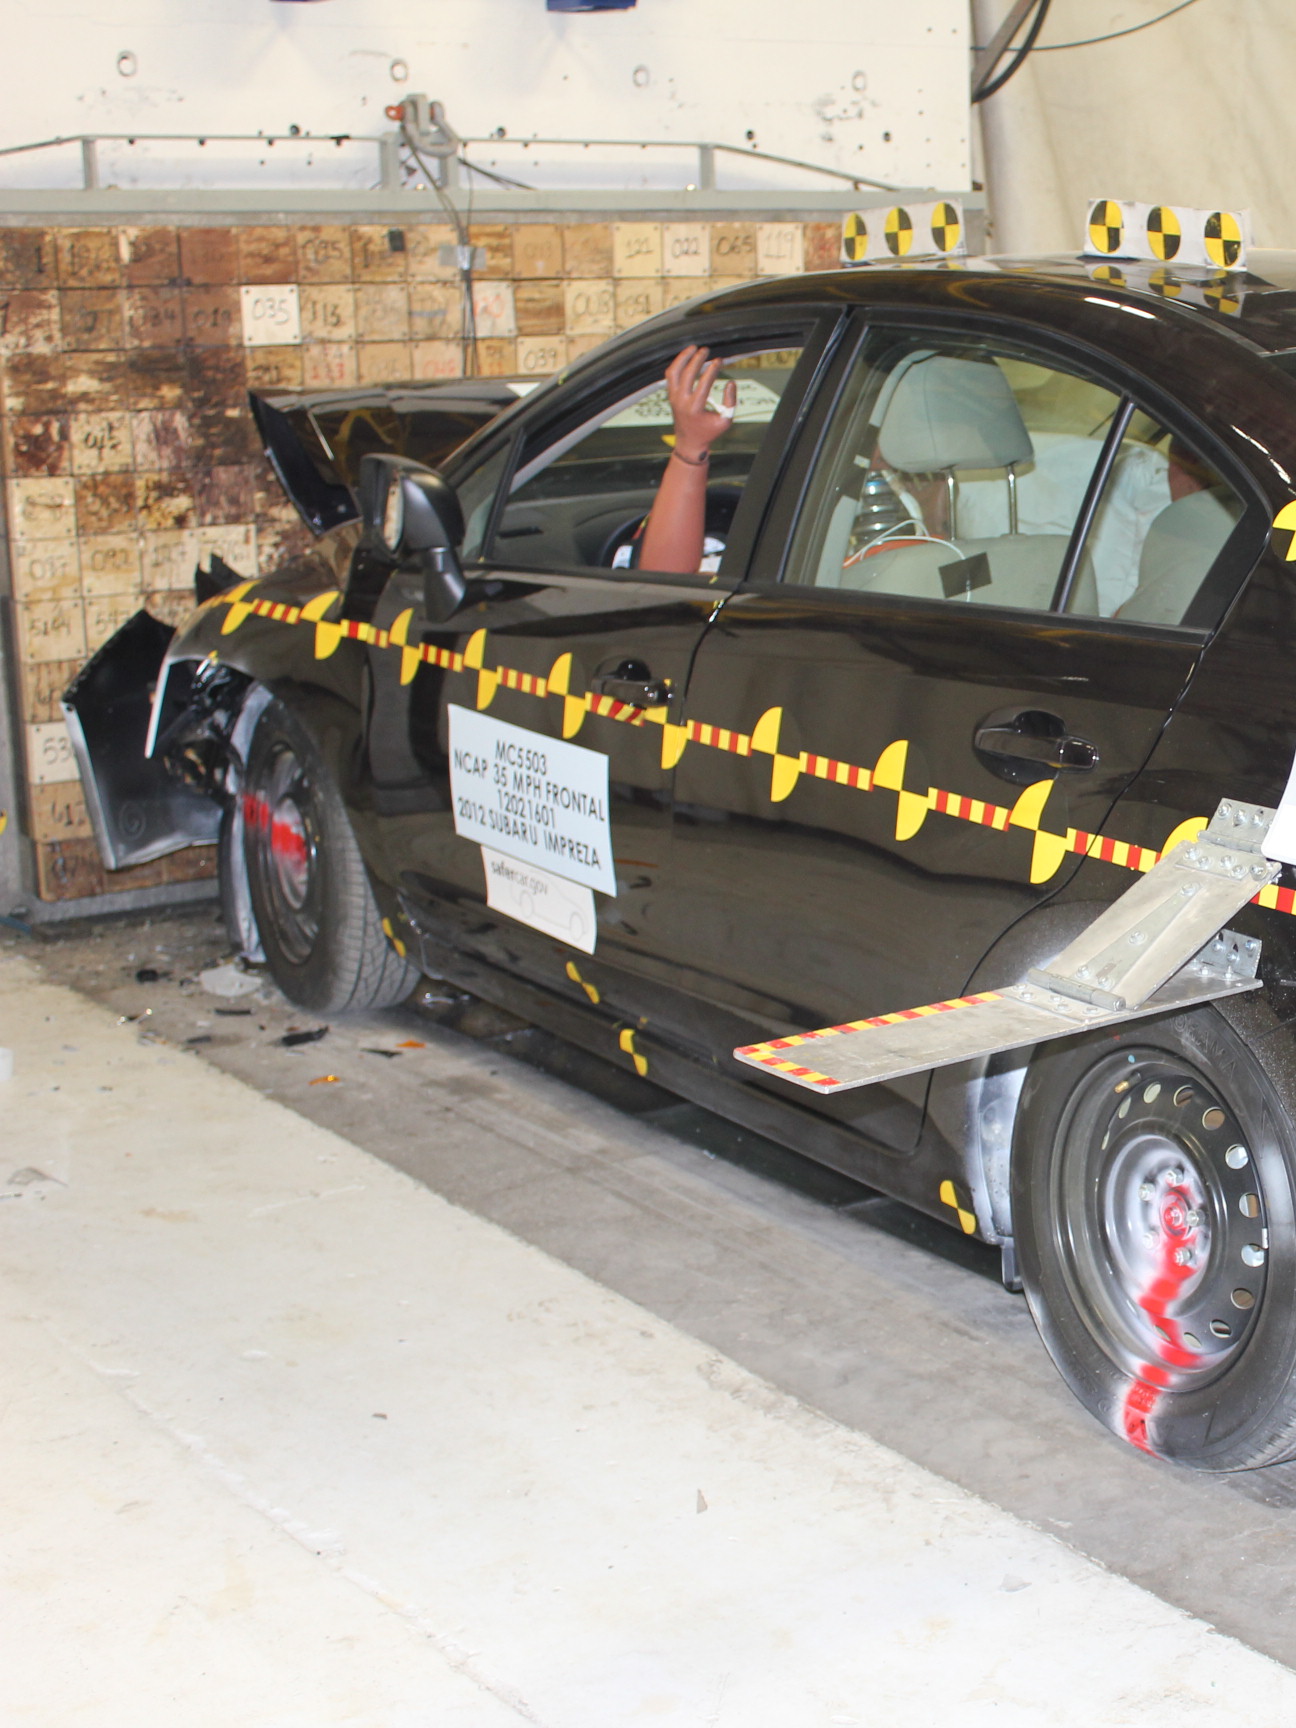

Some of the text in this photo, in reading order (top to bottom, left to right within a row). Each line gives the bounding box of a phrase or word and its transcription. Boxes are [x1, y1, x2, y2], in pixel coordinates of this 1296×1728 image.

[252, 297, 291, 325] 035
[495, 739, 547, 776] MC5503
[453, 750, 606, 823] NCAP 35 MPH FRONTAL
[498, 788, 556, 830] 12021601
[458, 796, 602, 870] 2012 SUBARU IMPREZA
[490, 860, 549, 896] safercar.gov
